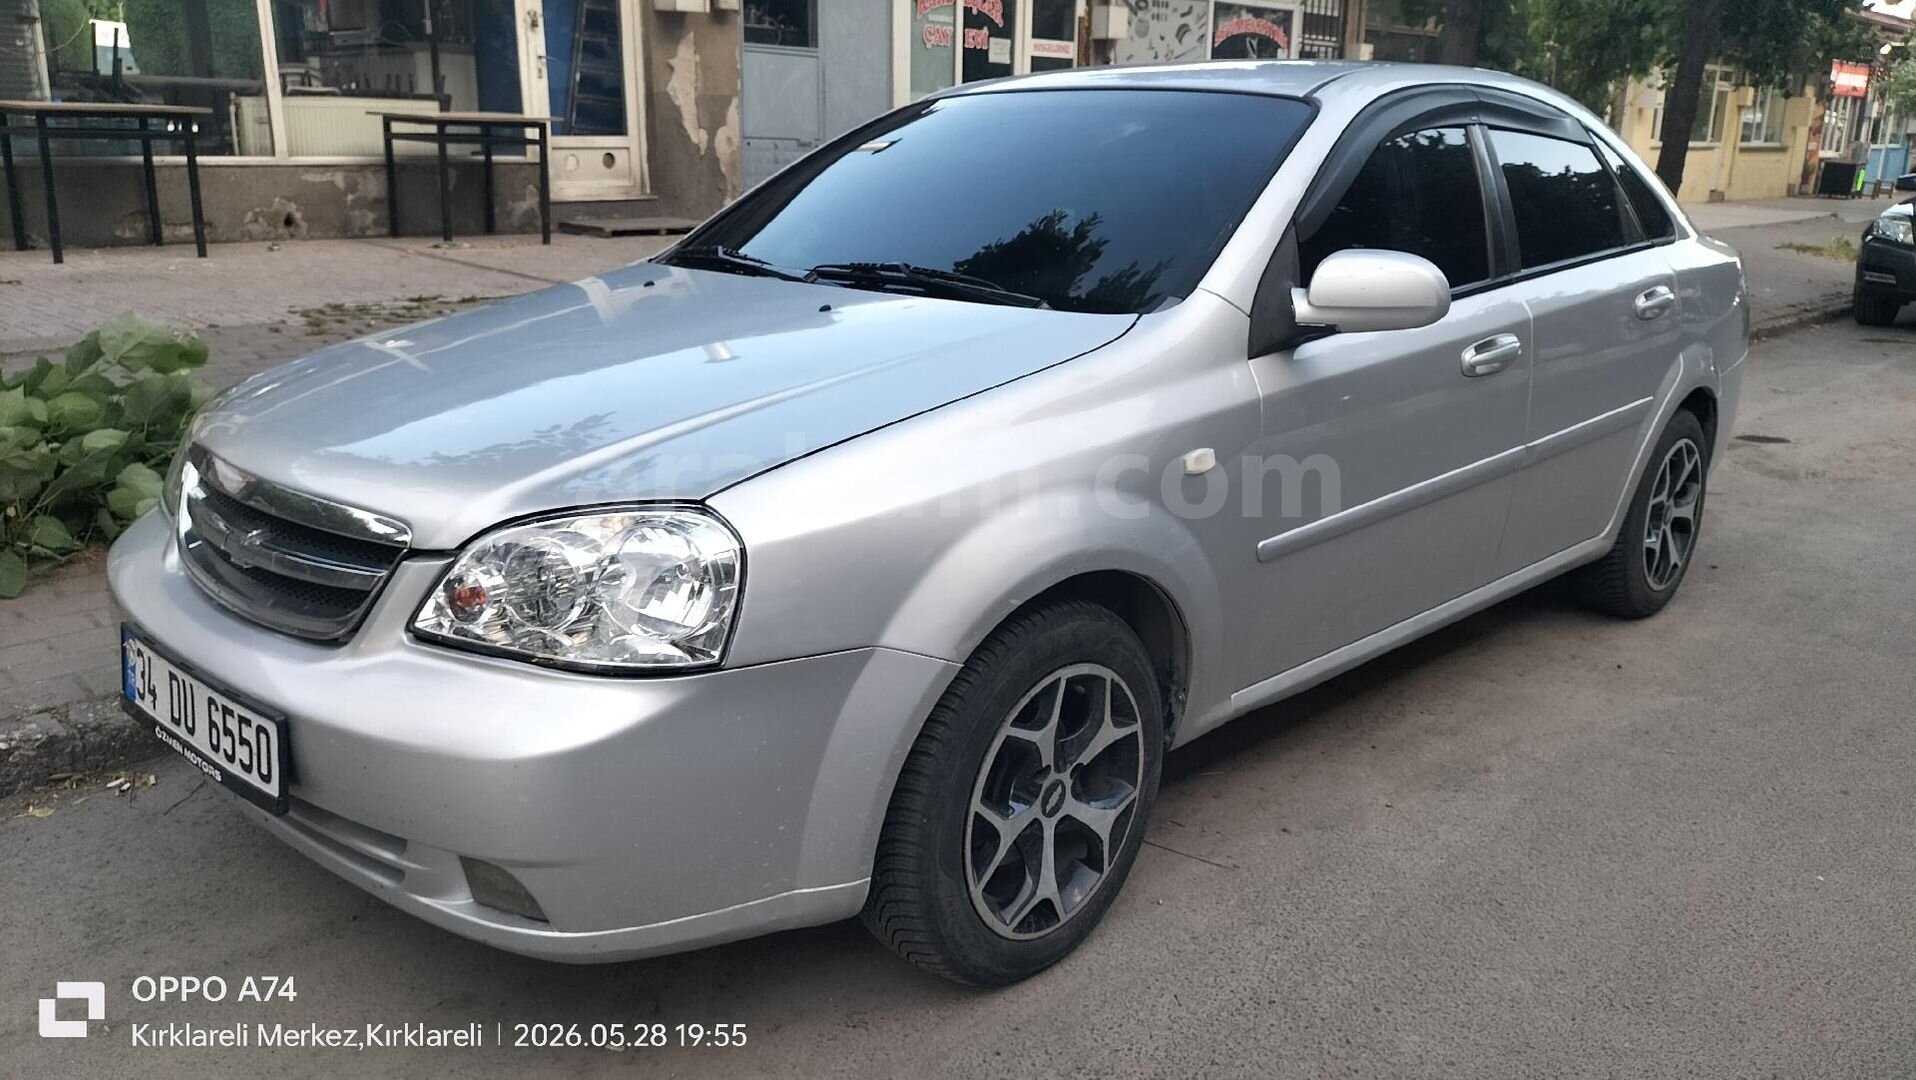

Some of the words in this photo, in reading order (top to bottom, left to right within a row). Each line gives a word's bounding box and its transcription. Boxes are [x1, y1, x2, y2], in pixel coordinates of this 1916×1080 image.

[923, 24, 954, 48] ÇAY
[136, 648, 158, 710] 34
[168, 670, 196, 737] DU
[207, 696, 272, 784] 6550
[184, 747, 222, 782] MOTORS
